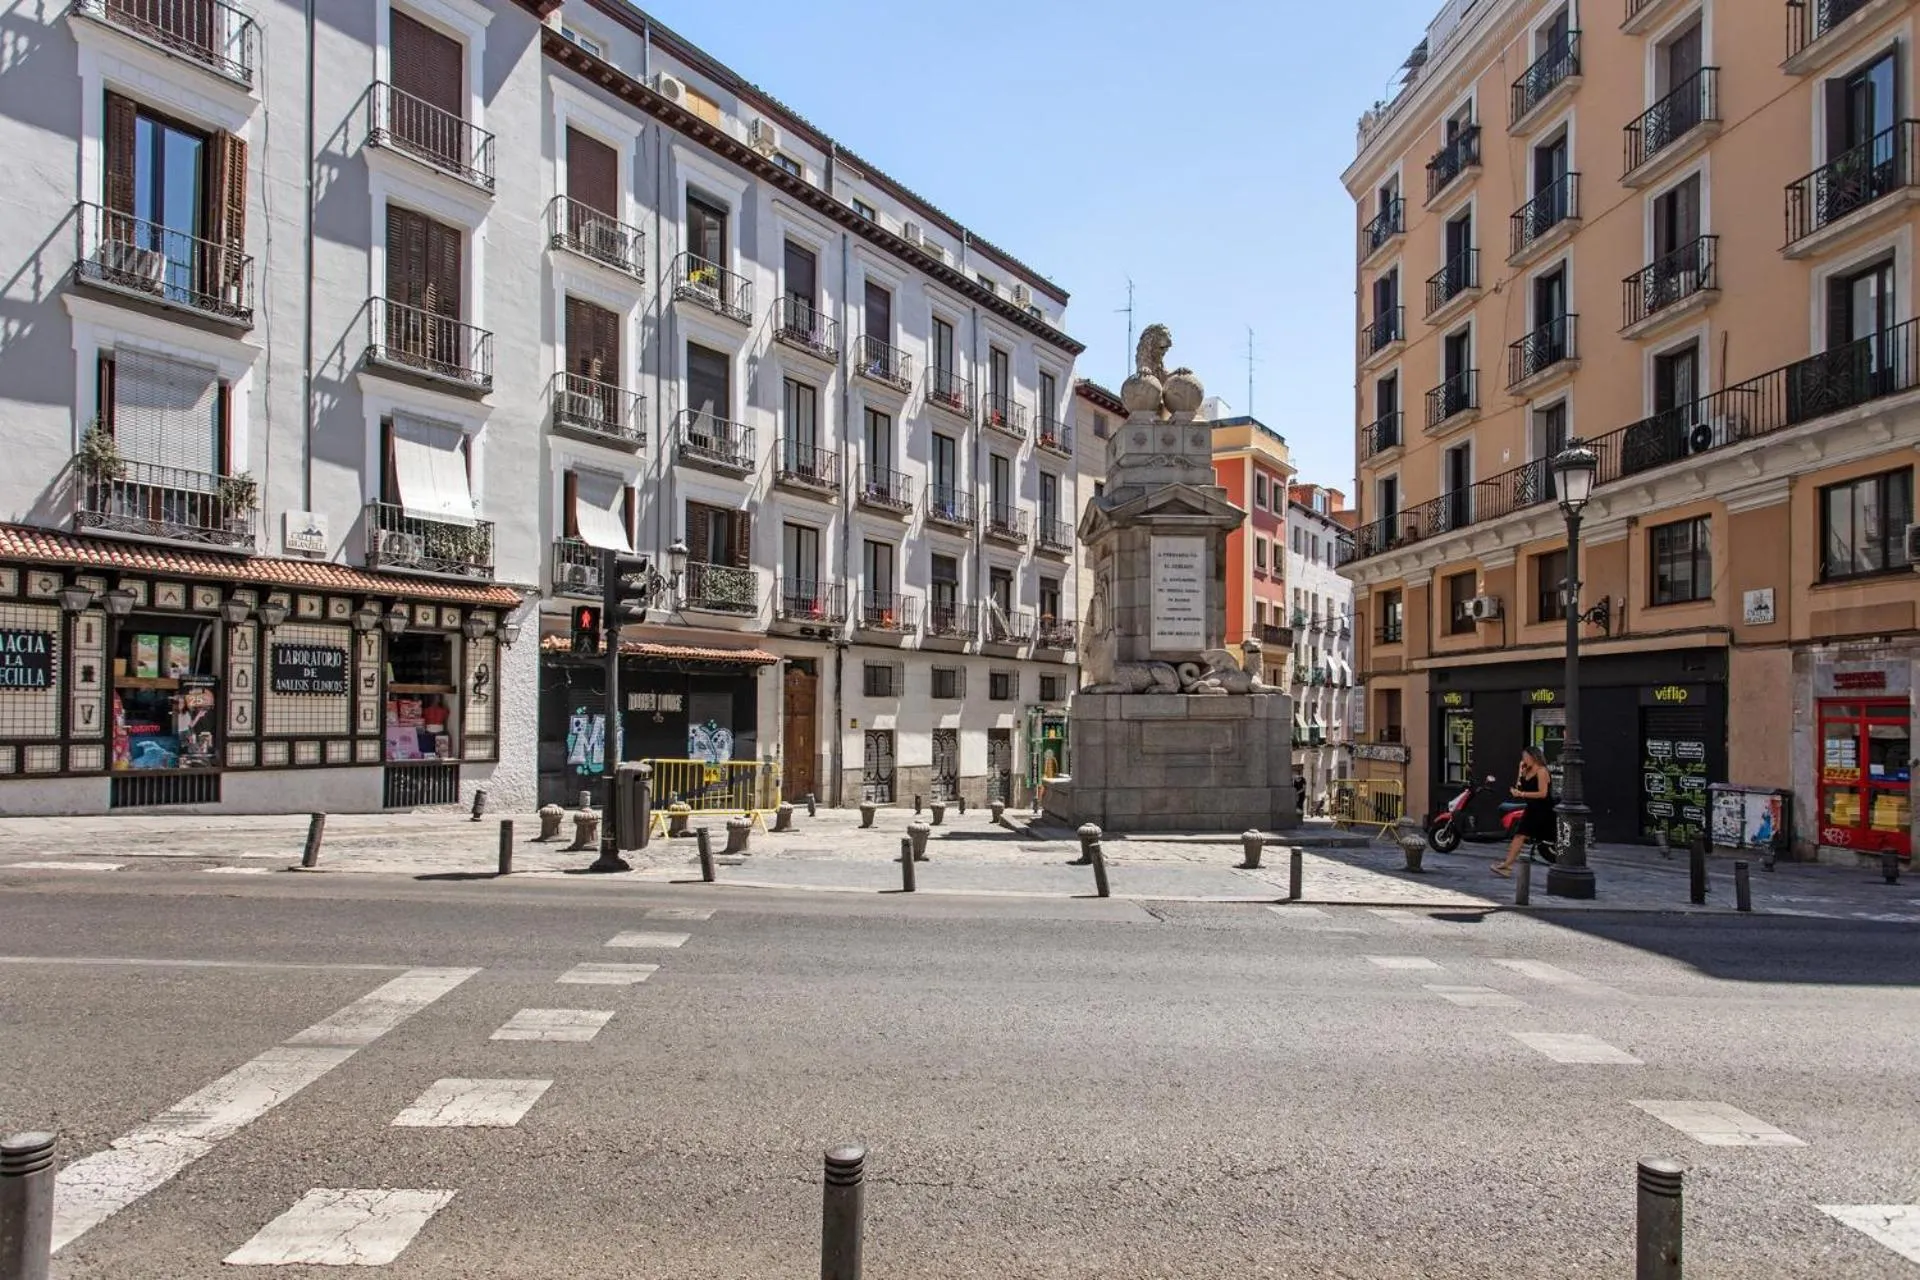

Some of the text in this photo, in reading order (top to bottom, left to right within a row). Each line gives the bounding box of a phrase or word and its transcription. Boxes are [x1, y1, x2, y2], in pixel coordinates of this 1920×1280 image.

[5, 654, 23, 666] LA
[278, 649, 342, 667] LABORATORIO
[303, 667, 318, 678] DE
[1825, 768, 1858, 779] DHL
